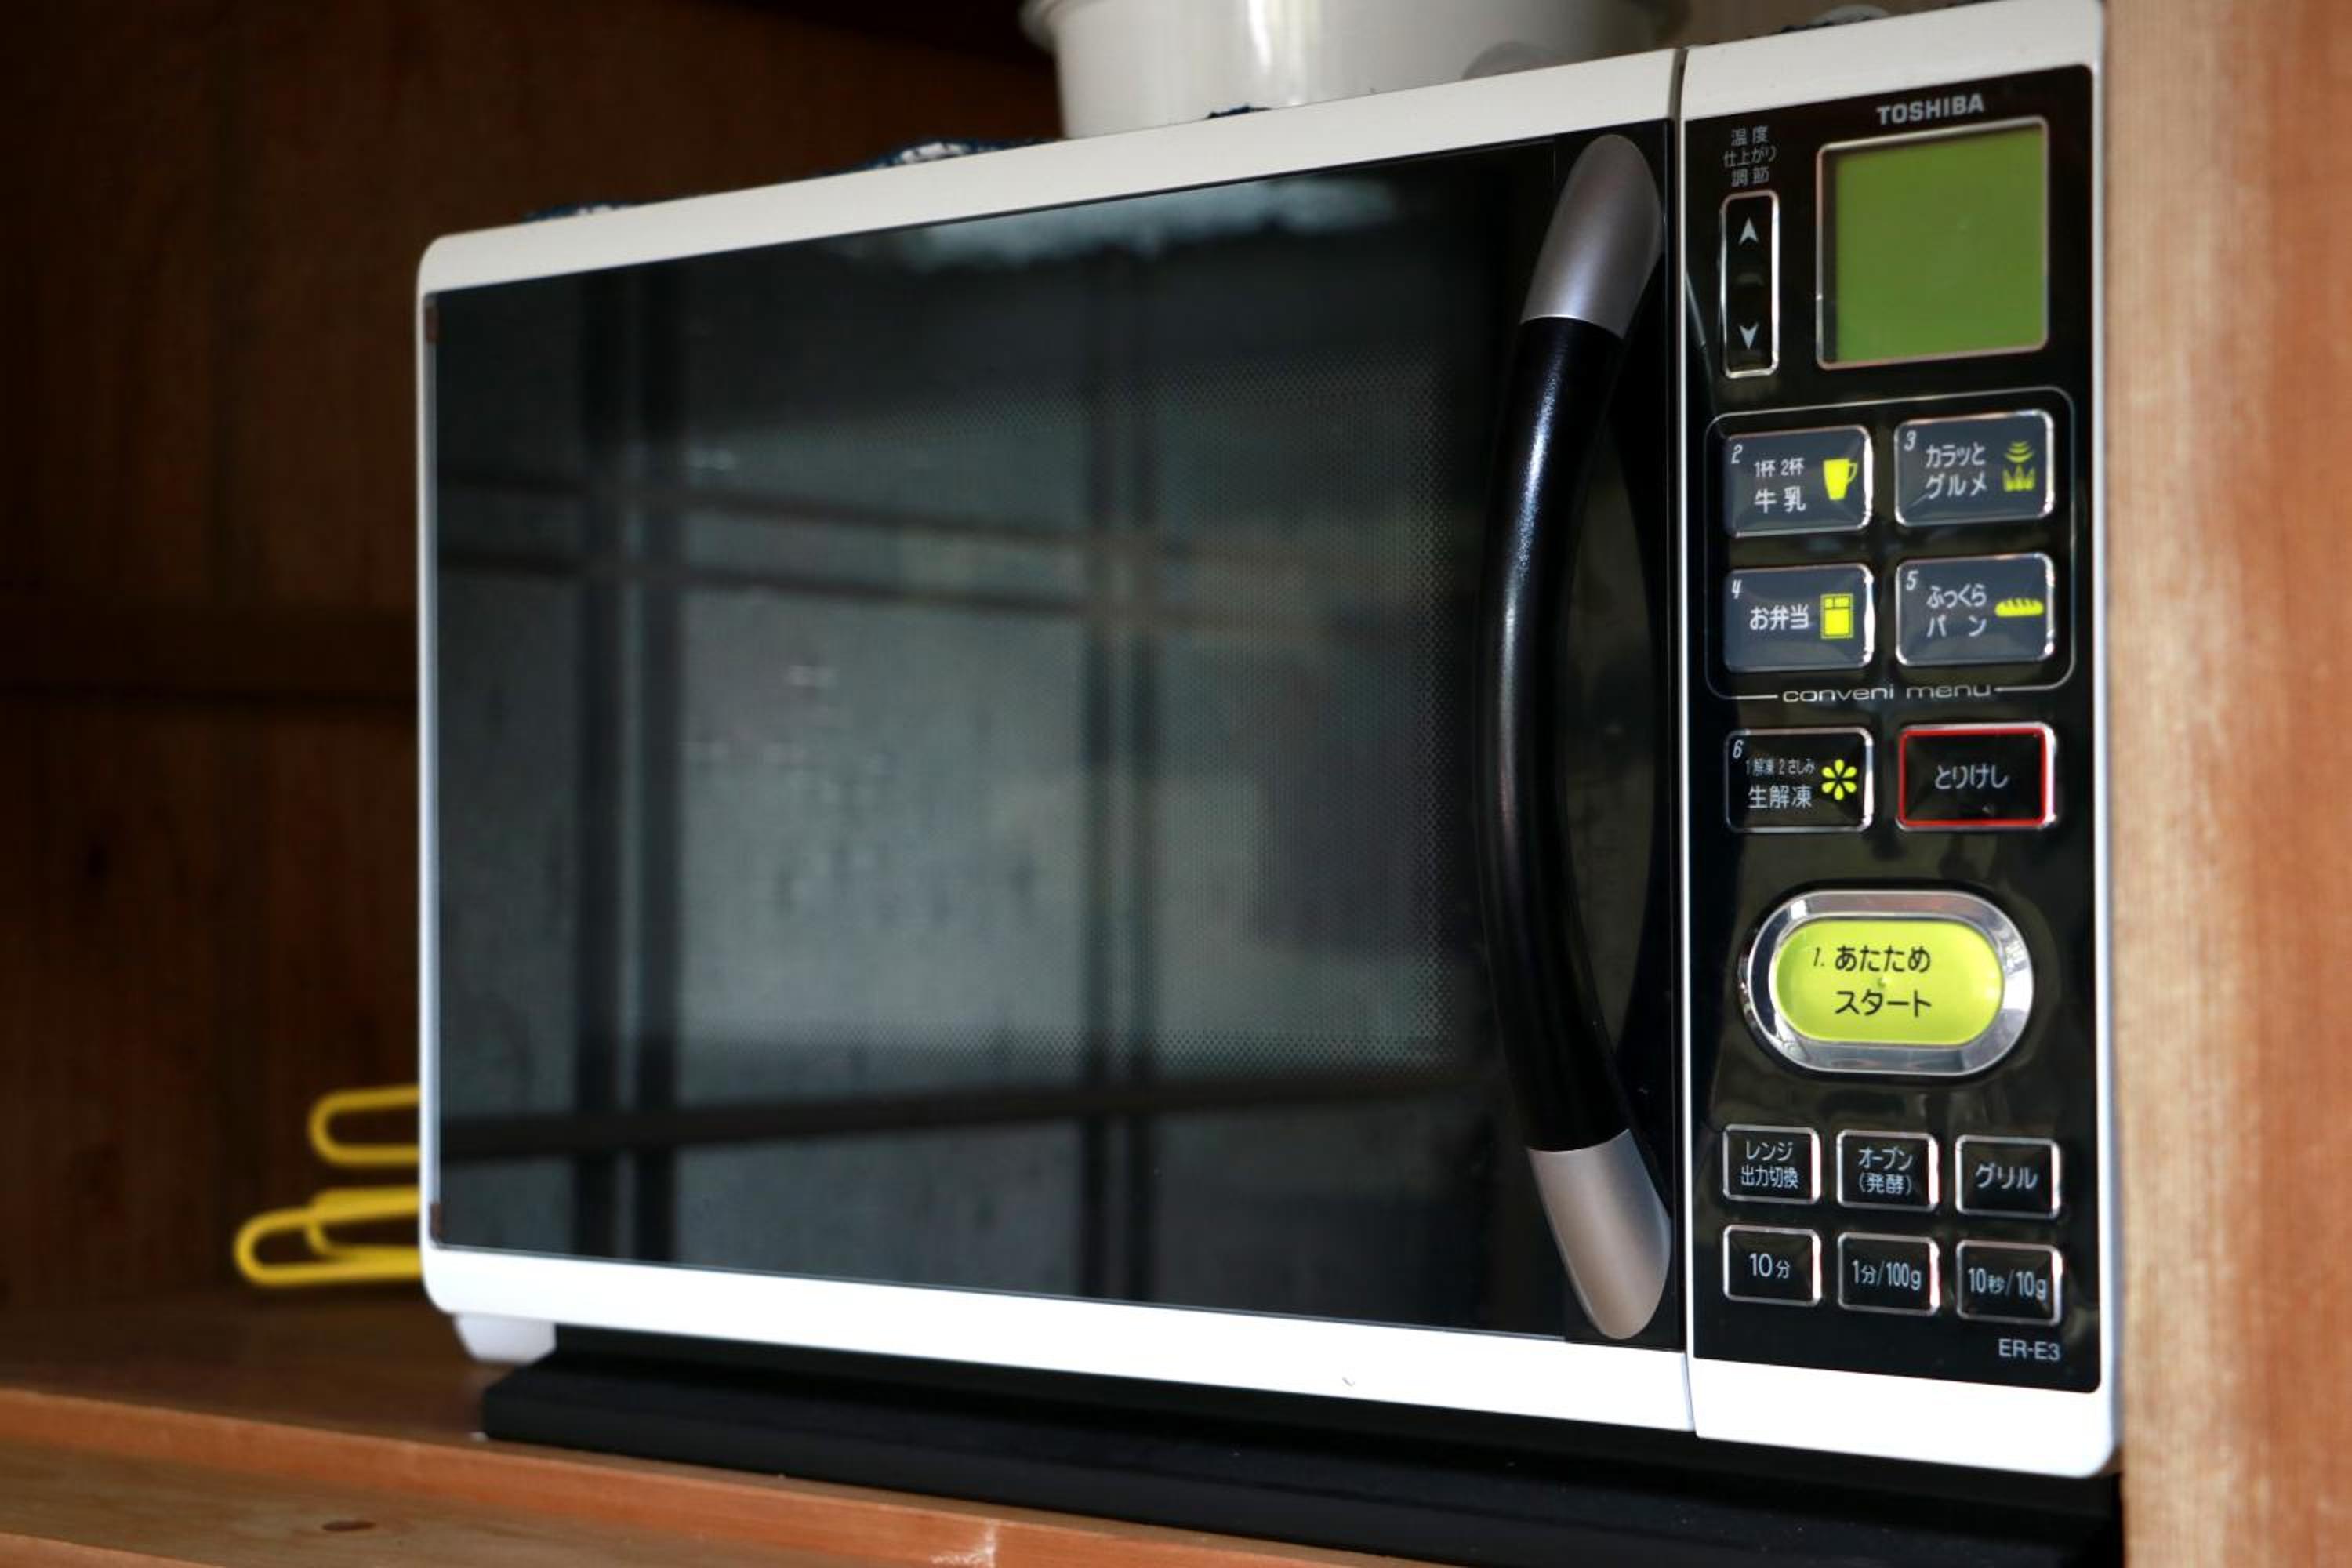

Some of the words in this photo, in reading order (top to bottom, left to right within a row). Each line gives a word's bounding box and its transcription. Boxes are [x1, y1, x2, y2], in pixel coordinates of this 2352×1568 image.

[1876, 93, 1985, 125] TOSHIBA
[1731, 125, 1769, 146] 温度
[1724, 146, 1777, 167] 仕上がり
[1731, 166, 1769, 187] 調節
[1904, 430, 1917, 452] 3
[1730, 445, 1743, 464] 2
[1926, 443, 1986, 469] カラッと
[1926, 475, 1988, 500] グルメ
[1754, 488, 1806, 513] 牛乳
[1731, 580, 1742, 599] 4
[1906, 571, 1918, 590] 5
[1926, 583, 1987, 608] ふっくら
[1749, 604, 1809, 630] お弁当
[1926, 615, 1987, 637] パン
[1783, 684, 1894, 702] conveni
[1906, 684, 1992, 699] menu
[1732, 739, 1744, 759] 6
[1934, 765, 2009, 790] とりけし
[1748, 785, 1813, 809] 生解凍
[1835, 946, 1931, 974] あたため
[1835, 990, 1932, 1018] スタート
[1745, 1141, 1793, 1160] レンジ
[1858, 1147, 1913, 1169] オーブン
[1740, 1165, 1799, 1189] 出力切換
[1859, 1174, 1912, 1196] (発酵)
[1976, 1163, 2038, 1190] グリル
[1749, 1253, 1790, 1279] 10分
[1998, 1338, 2060, 1361] ER-E3
